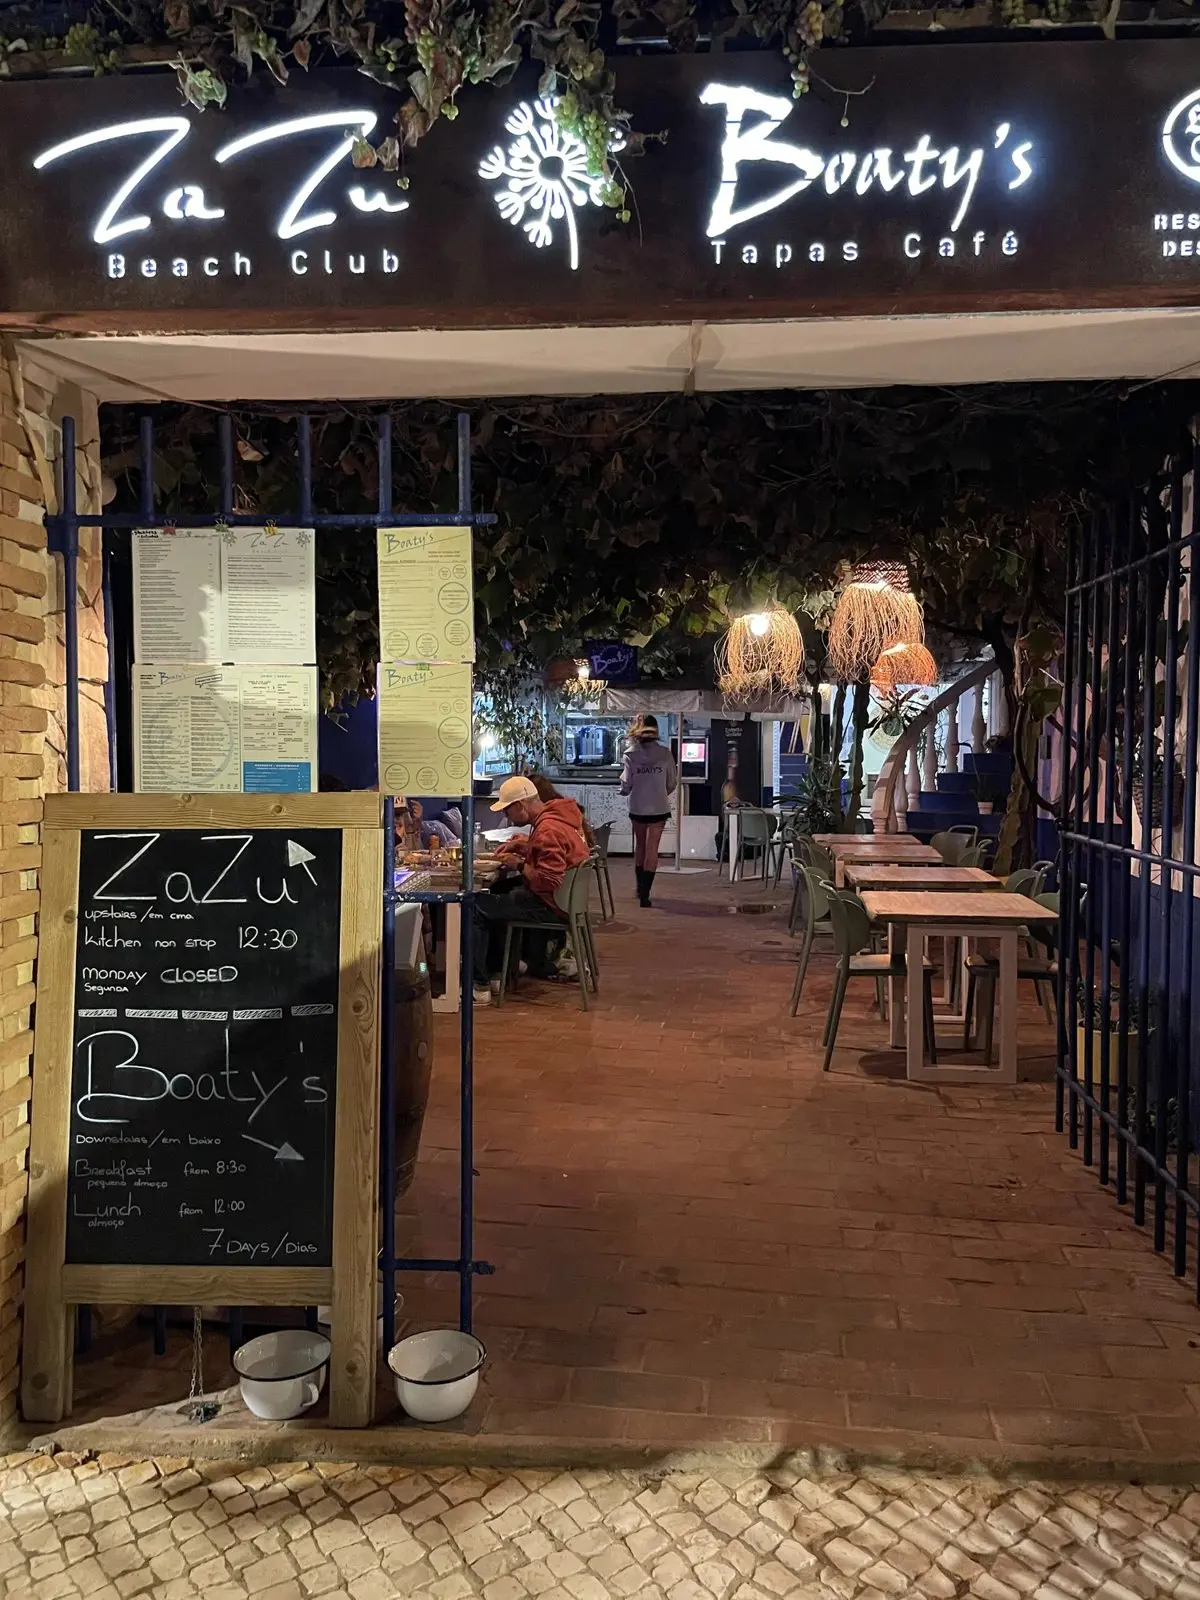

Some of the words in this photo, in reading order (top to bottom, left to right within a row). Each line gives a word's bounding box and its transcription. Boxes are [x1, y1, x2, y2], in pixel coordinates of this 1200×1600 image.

[699, 82, 1036, 236] Boaty's
[709, 240, 860, 269] Tapas
[903, 228, 1020, 258] Café
[107, 251, 252, 279] Beach
[290, 248, 400, 275] Club
[384, 532, 434, 554] Boaty's
[385, 669, 434, 687] Boaty's
[84, 925, 142, 948] kitchen
[154, 939, 177, 948] non
[238, 925, 299, 950] 12:30
[159, 965, 239, 983] CLOSED
[76, 1028, 328, 1124] Boaty's
[73, 1191, 142, 1217] Lunch
[201, 1228, 225, 1256] 7
